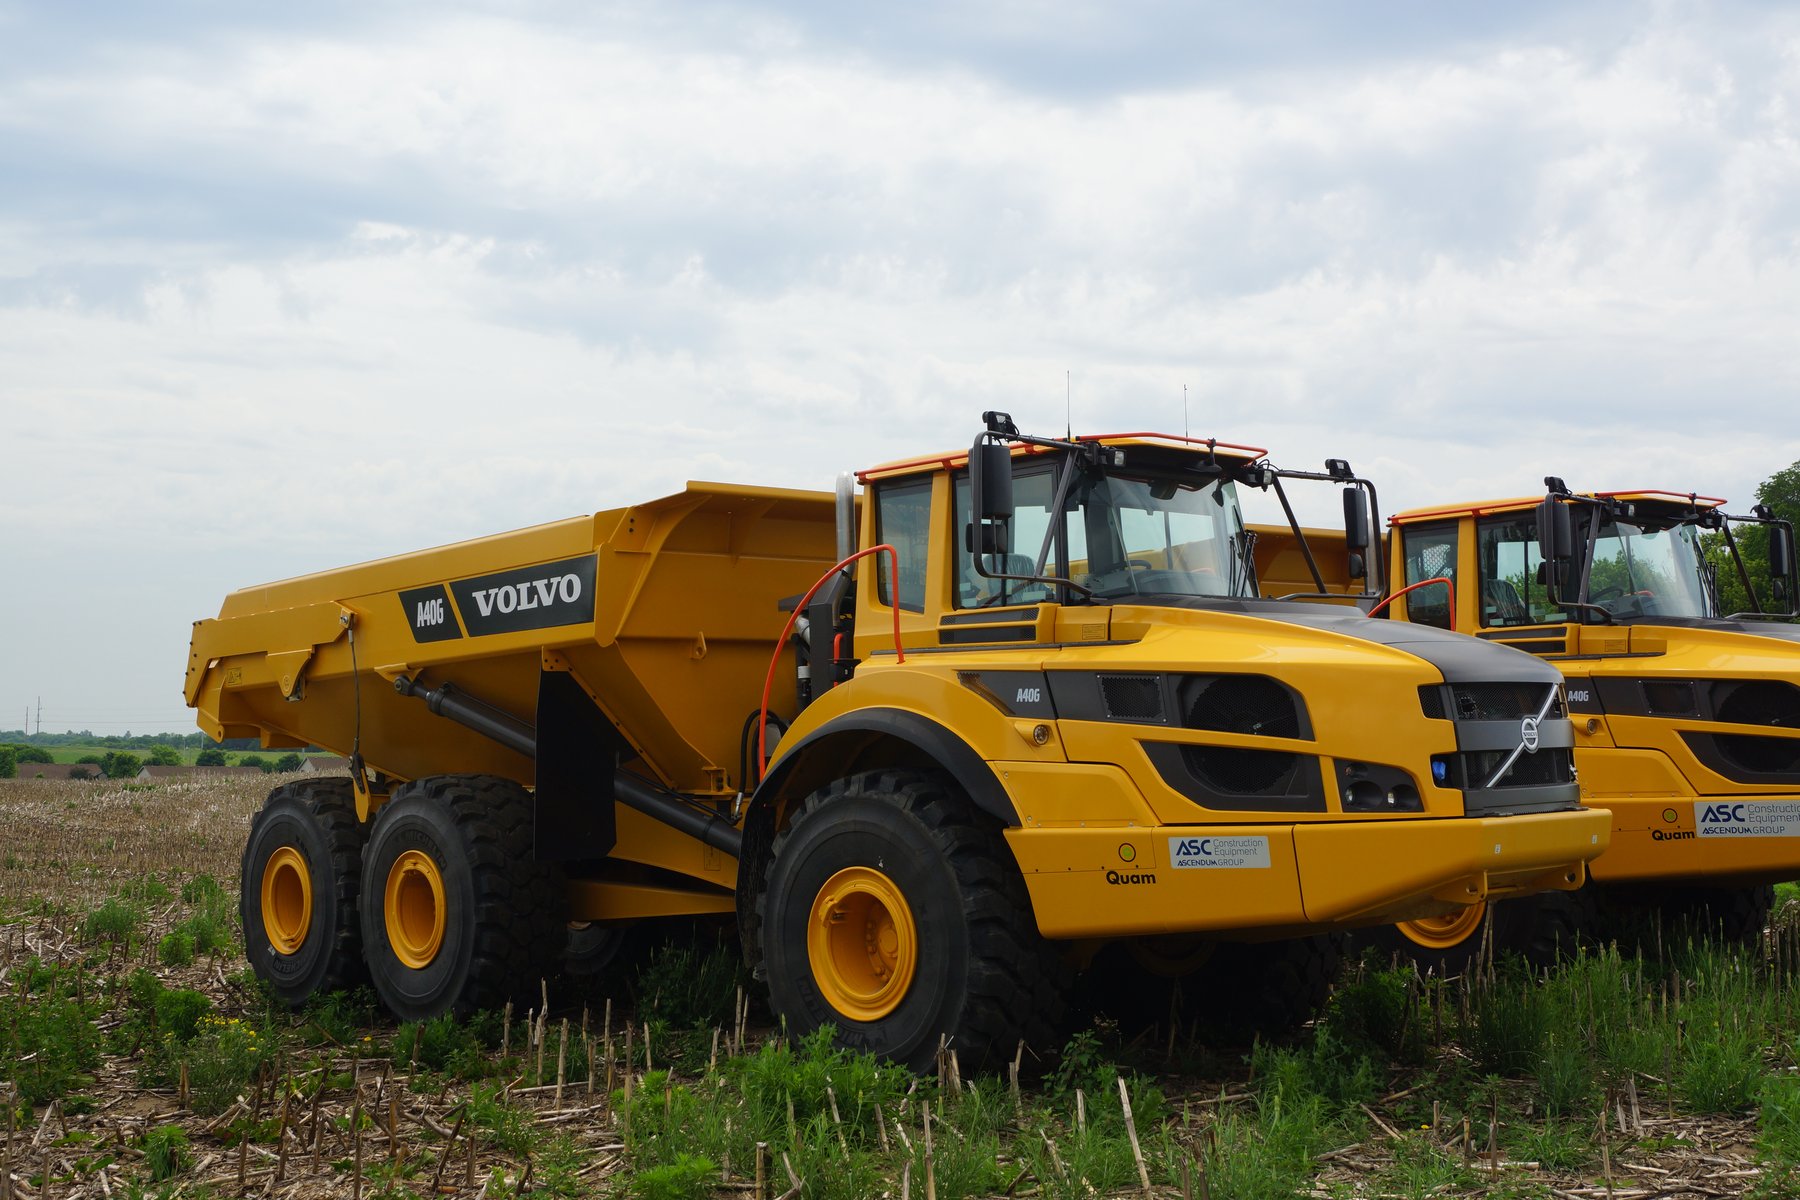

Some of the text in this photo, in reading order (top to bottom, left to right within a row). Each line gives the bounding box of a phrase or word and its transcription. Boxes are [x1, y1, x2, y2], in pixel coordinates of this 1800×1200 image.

[472, 573, 582, 617] VOLVO
[417, 598, 444, 628] A40G
[1016, 688, 1040, 703] A40G
[1567, 690, 1589, 702] A40G
[1701, 804, 1745, 822] ASC
[1652, 830, 1695, 841] Quam
[1702, 826, 1785, 834] ASCENDUM GROUP
[1176, 839, 1212, 855] ASC
[1212, 838, 1263, 848] Construction
[1214, 847, 1258, 857] Equipment
[1106, 870, 1156, 885] Quam
